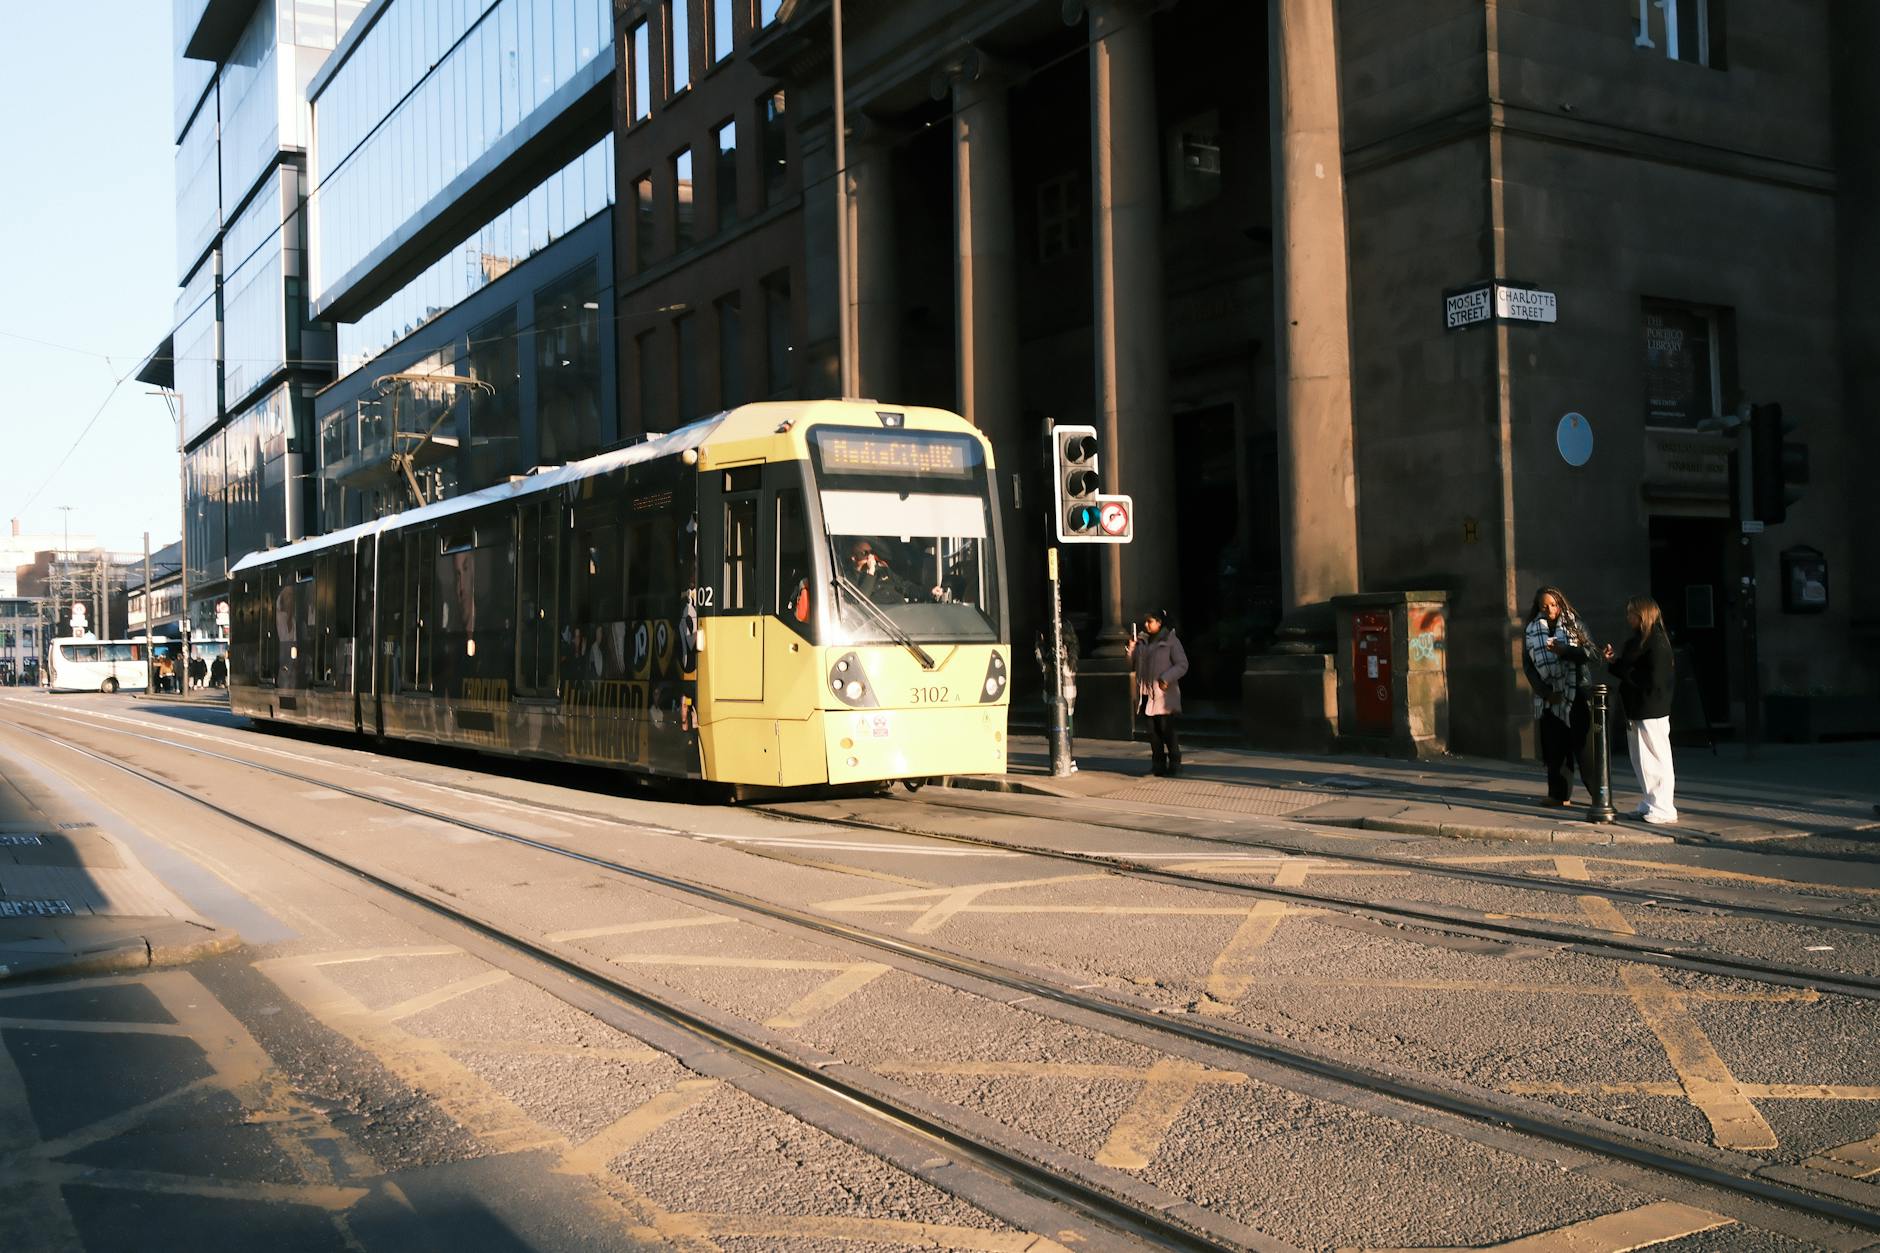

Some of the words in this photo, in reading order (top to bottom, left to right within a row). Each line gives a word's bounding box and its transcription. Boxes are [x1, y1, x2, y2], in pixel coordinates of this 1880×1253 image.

[1448, 290, 1489, 312] MOSLEY
[1500, 289, 1555, 307] CHARLOTTE
[1449, 307, 1485, 326] STREET
[1511, 305, 1545, 319] STREET
[1647, 328, 1684, 340] PORTICO
[1647, 340, 1682, 352] LIBRARY
[833, 439, 954, 471] MediaCityUK
[910, 686, 949, 704] 3102
